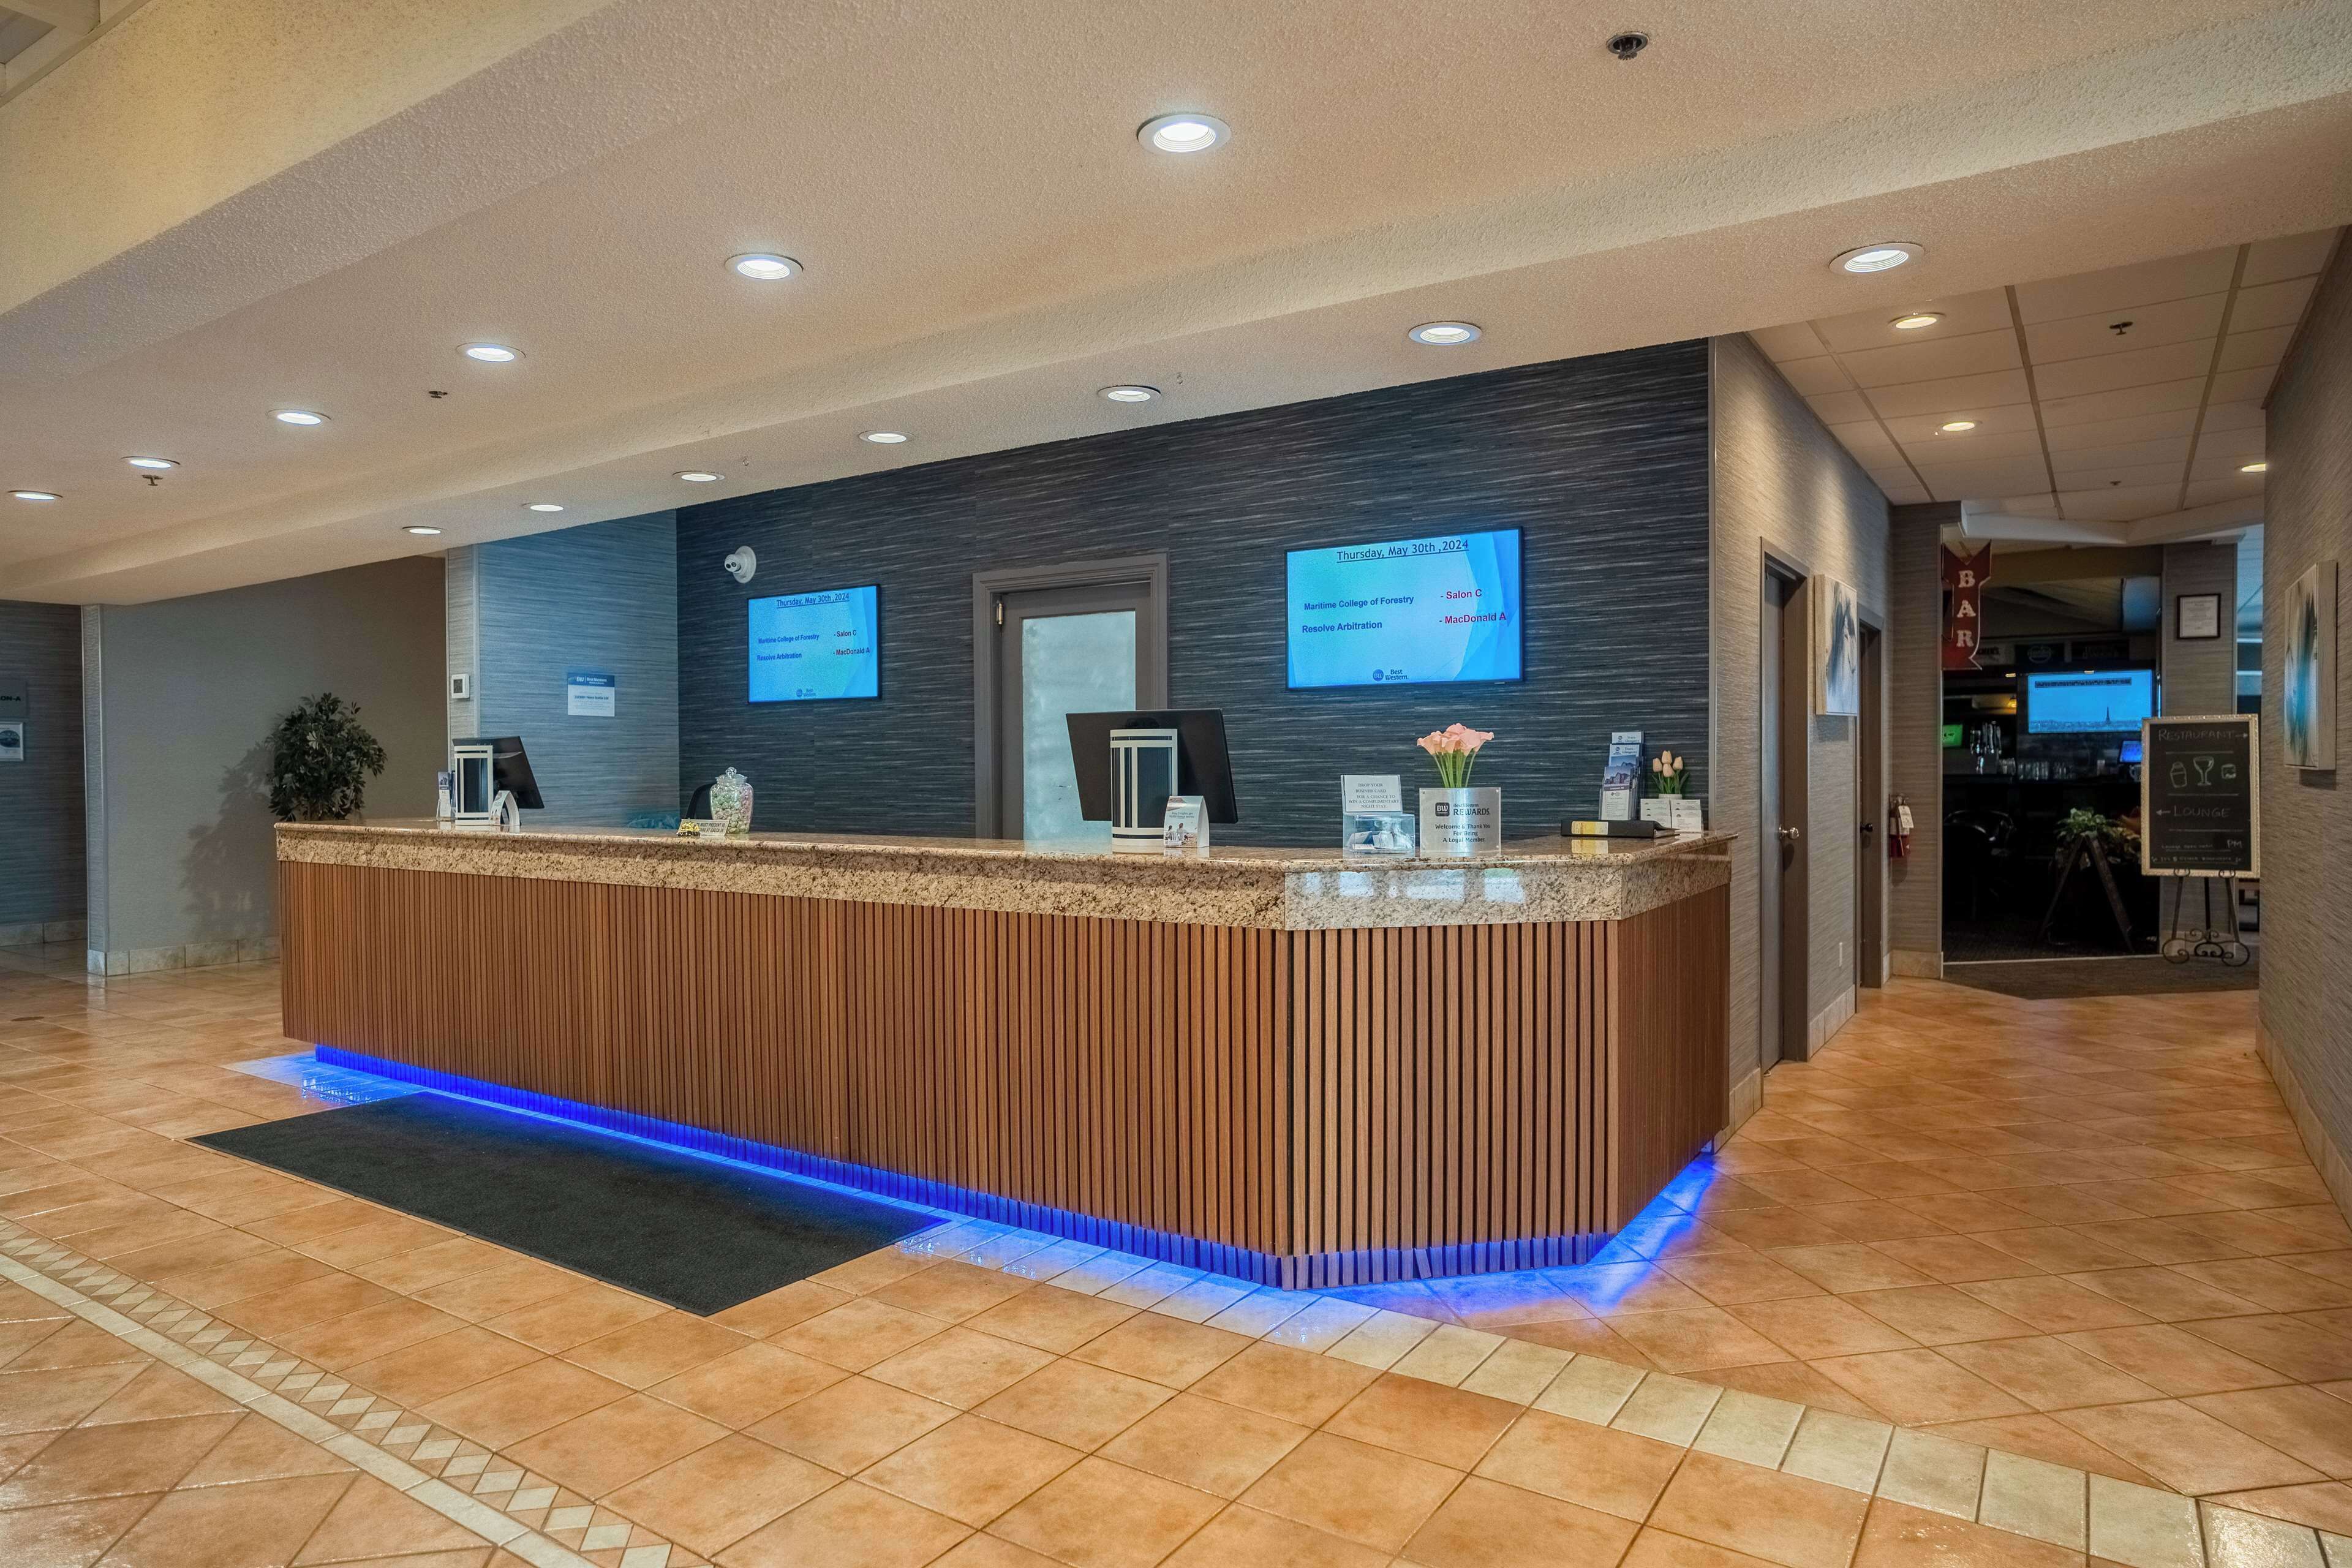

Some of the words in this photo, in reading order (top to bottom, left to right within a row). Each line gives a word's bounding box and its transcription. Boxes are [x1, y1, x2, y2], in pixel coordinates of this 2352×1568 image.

[1337, 549, 1384, 560] Thursday,
[1388, 546, 1409, 557] May
[1412, 543, 1435, 554] 30th
[777, 598, 803, 606] Thursday,
[818, 594, 831, 603] 30th
[1446, 590, 1472, 599] Salon
[1475, 589, 1482, 597] C
[1338, 600, 1368, 608] College
[1380, 596, 1414, 605] Forestry
[1445, 612, 1496, 624] MacDonald
[1499, 612, 1506, 620] A
[1302, 624, 1335, 633] Resolve
[1337, 621, 1382, 631] Arbitration
[2158, 728, 2235, 741] RESTAURANT
[2174, 805, 2230, 817] LOUNGE
[2227, 839, 2242, 848] PM
